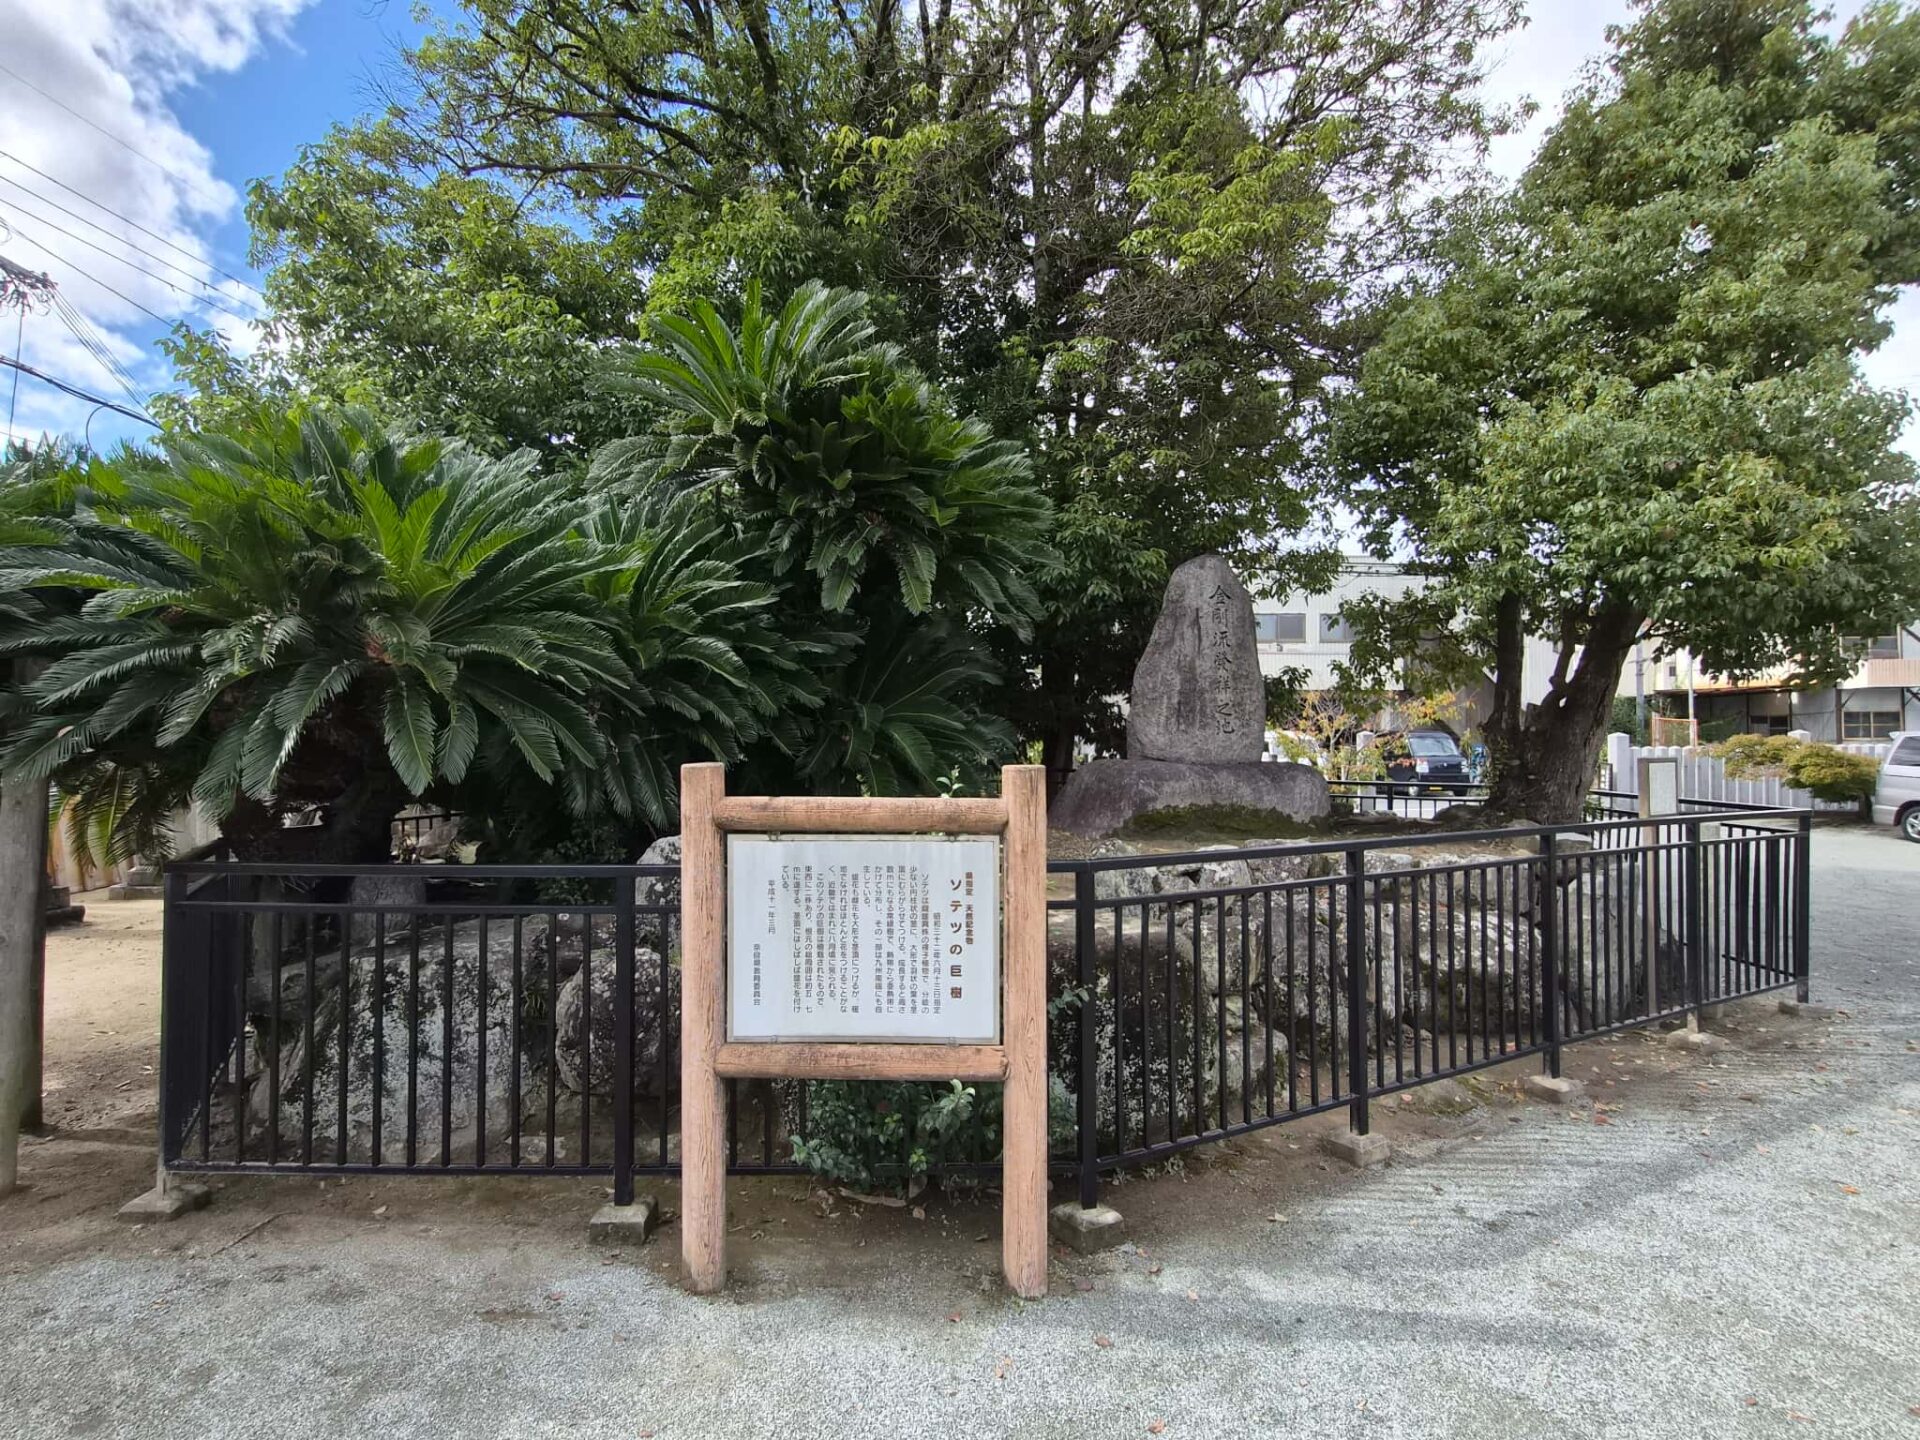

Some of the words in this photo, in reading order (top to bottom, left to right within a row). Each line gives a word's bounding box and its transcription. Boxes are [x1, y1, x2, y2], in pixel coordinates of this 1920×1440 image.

[950, 879, 963, 999] ソテツの巨樹
